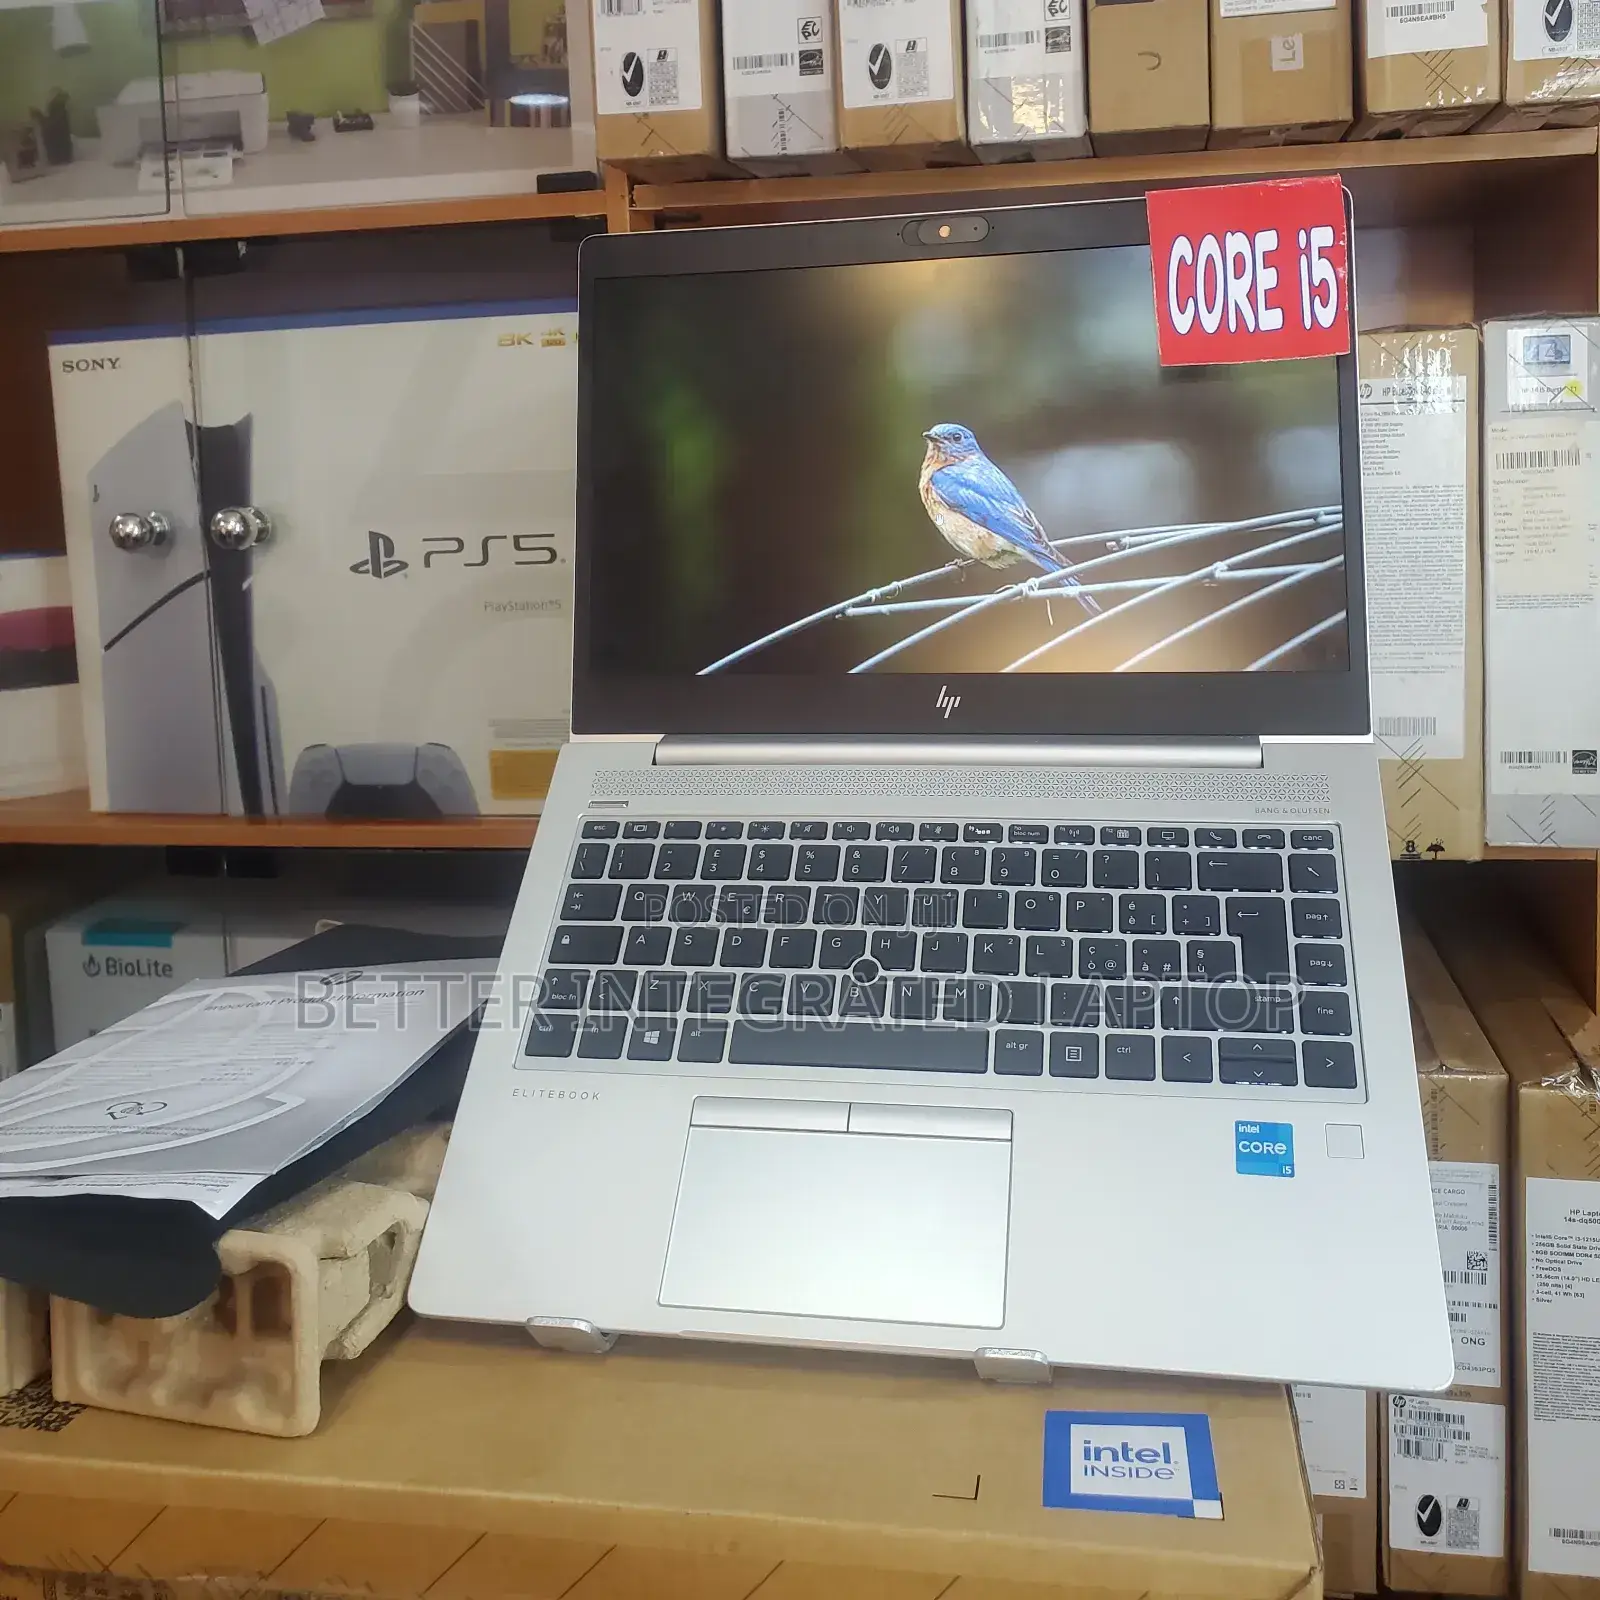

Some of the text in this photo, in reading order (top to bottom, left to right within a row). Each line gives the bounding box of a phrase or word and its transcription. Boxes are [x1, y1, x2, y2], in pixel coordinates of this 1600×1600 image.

[1167, 225, 1339, 335] CORE i5
[62, 357, 121, 373] SONY
[422, 533, 558, 569] PS5
[1303, 834, 1323, 842] canc
[713, 850, 721, 858] £
[759, 850, 766, 859] $
[806, 850, 815, 860] %
[853, 850, 861, 859] &
[617, 863, 622, 871] 1
[662, 863, 671, 872] 2
[709, 863, 717, 873] 3
[756, 864, 764, 873] 4
[804, 864, 812, 873] 5
[851, 865, 859, 874] 6
[901, 866, 908, 875] 7
[950, 866, 959, 876] 8
[1000, 868, 1009, 878] 9
[634, 891, 645, 901] Q
[682, 892, 696, 901] W
[728, 892, 736, 902] E
[775, 893, 784, 903] R
[824, 893, 832, 903] T
[874, 895, 883, 904] Y
[923, 896, 933, 906] U
[1025, 898, 1036, 909] O
[1076, 901, 1085, 911] P
[1306, 913, 1323, 922] pag
[636, 935, 646, 945] A
[684, 935, 693, 946] S
[732, 936, 742, 946] D
[780, 937, 789, 947] F
[831, 937, 842, 948] G
[881, 938, 890, 950] H
[931, 941, 939, 951] J
[983, 942, 994, 953] K
[1036, 944, 1044, 955] L
[106, 956, 174, 978] BioLite
[1105, 959, 1117, 970] @
[1163, 963, 1172, 972] #
[1310, 960, 1327, 968] pag
[650, 980, 660, 990] Z
[699, 981, 710, 991] X
[749, 981, 760, 993] C
[800, 983, 811, 993] V
[850, 986, 859, 998] B
[902, 986, 912, 997] N
[955, 988, 967, 999] M
[563, 993, 577, 1001] fn
[1255, 995, 1281, 1004] stamp
[1317, 1006, 1335, 1015] fine
[690, 1029, 701, 1038] alt
[1005, 1041, 1029, 1051] alt gr
[1116, 1046, 1132, 1054] ctrl
[512, 1088, 601, 1101] ELITEBOOK
[1238, 1124, 1260, 1134] intel
[1282, 1166, 1292, 1175] i5
[1569, 1208, 1581, 1216] HP
[1549, 1250, 1575, 1258] SODIMM
[1535, 1265, 1562, 1273] FreeDOS
[1460, 1336, 1486, 1347] ONG
[1083, 1440, 1172, 1465] intel
